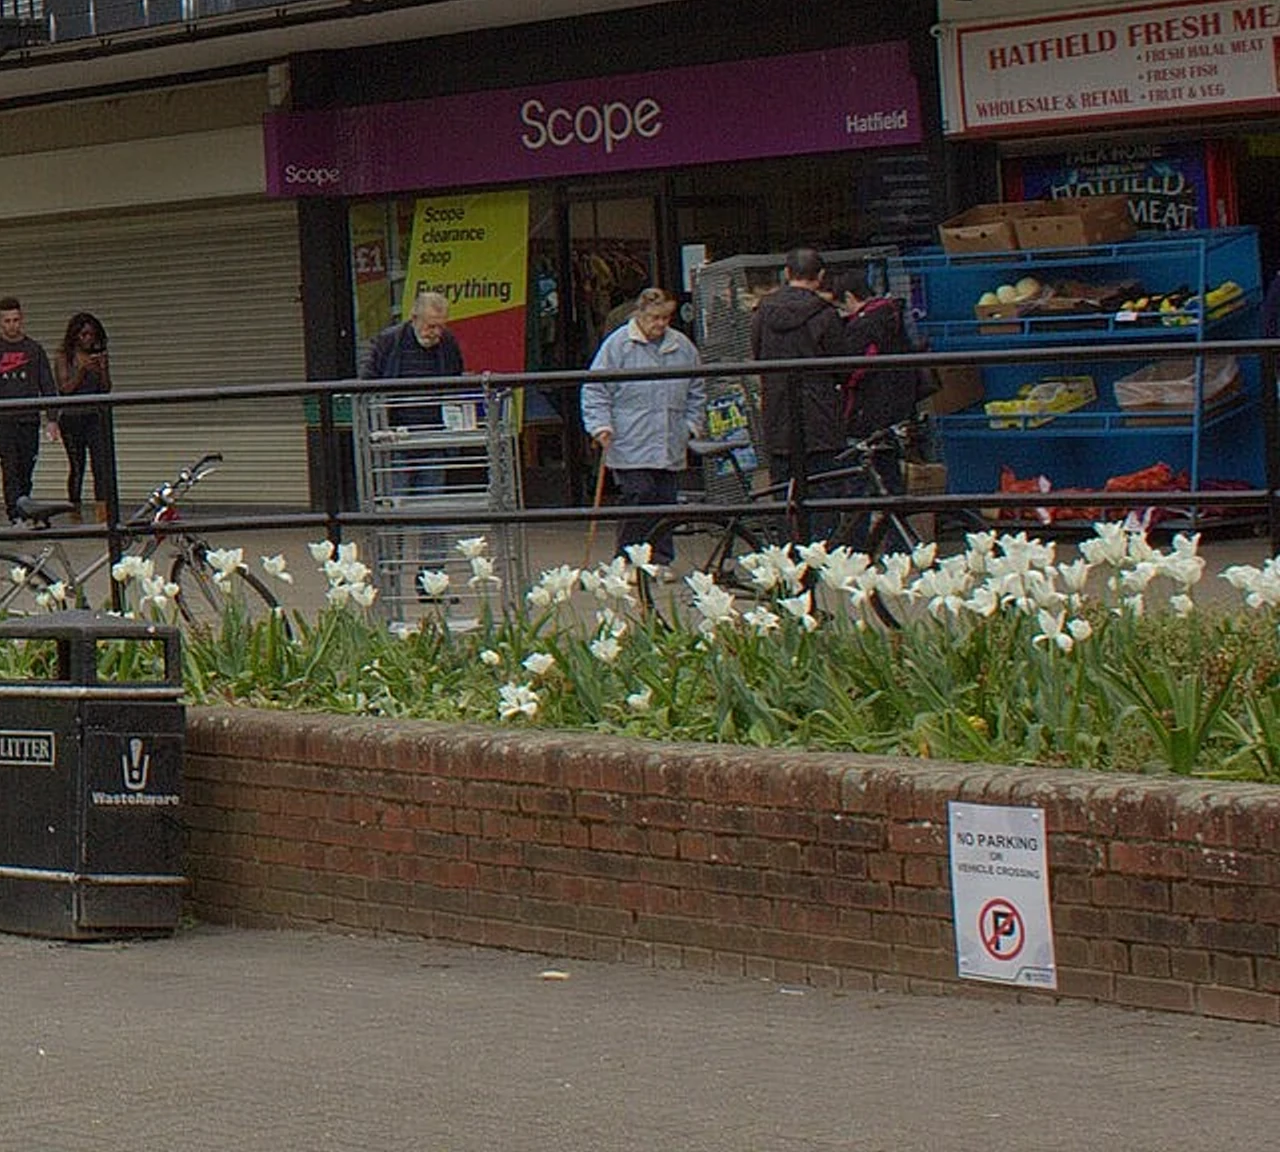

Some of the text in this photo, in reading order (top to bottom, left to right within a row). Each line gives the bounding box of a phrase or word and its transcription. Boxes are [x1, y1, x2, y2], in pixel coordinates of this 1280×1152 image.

[989, 30, 1117, 70] HATFIELD
[1128, 12, 1221, 47] FRESH
[1146, 37, 1265, 63] FRESH HALAL MEAT
[1147, 64, 1218, 83] FRESH FISH
[976, 96, 1064, 118] WHOLESALE
[1081, 88, 1133, 109] RETAIL
[1149, 87, 1185, 103] FRUIT
[1200, 84, 1225, 98] VEG
[522, 96, 663, 153] Scope
[846, 110, 908, 136] Hatfield
[285, 164, 339, 187] Scope
[1051, 171, 1186, 200] HATFIELD
[424, 206, 465, 225] Scope
[422, 227, 486, 244] clearance
[355, 247, 385, 273] £1
[418, 249, 451, 267] shop
[0, 737, 50, 759] LITTER
[92, 791, 180, 805] WasteAware
[957, 832, 1038, 851] NO PARKING
[958, 862, 1041, 880] VEHICLE CROSSING
